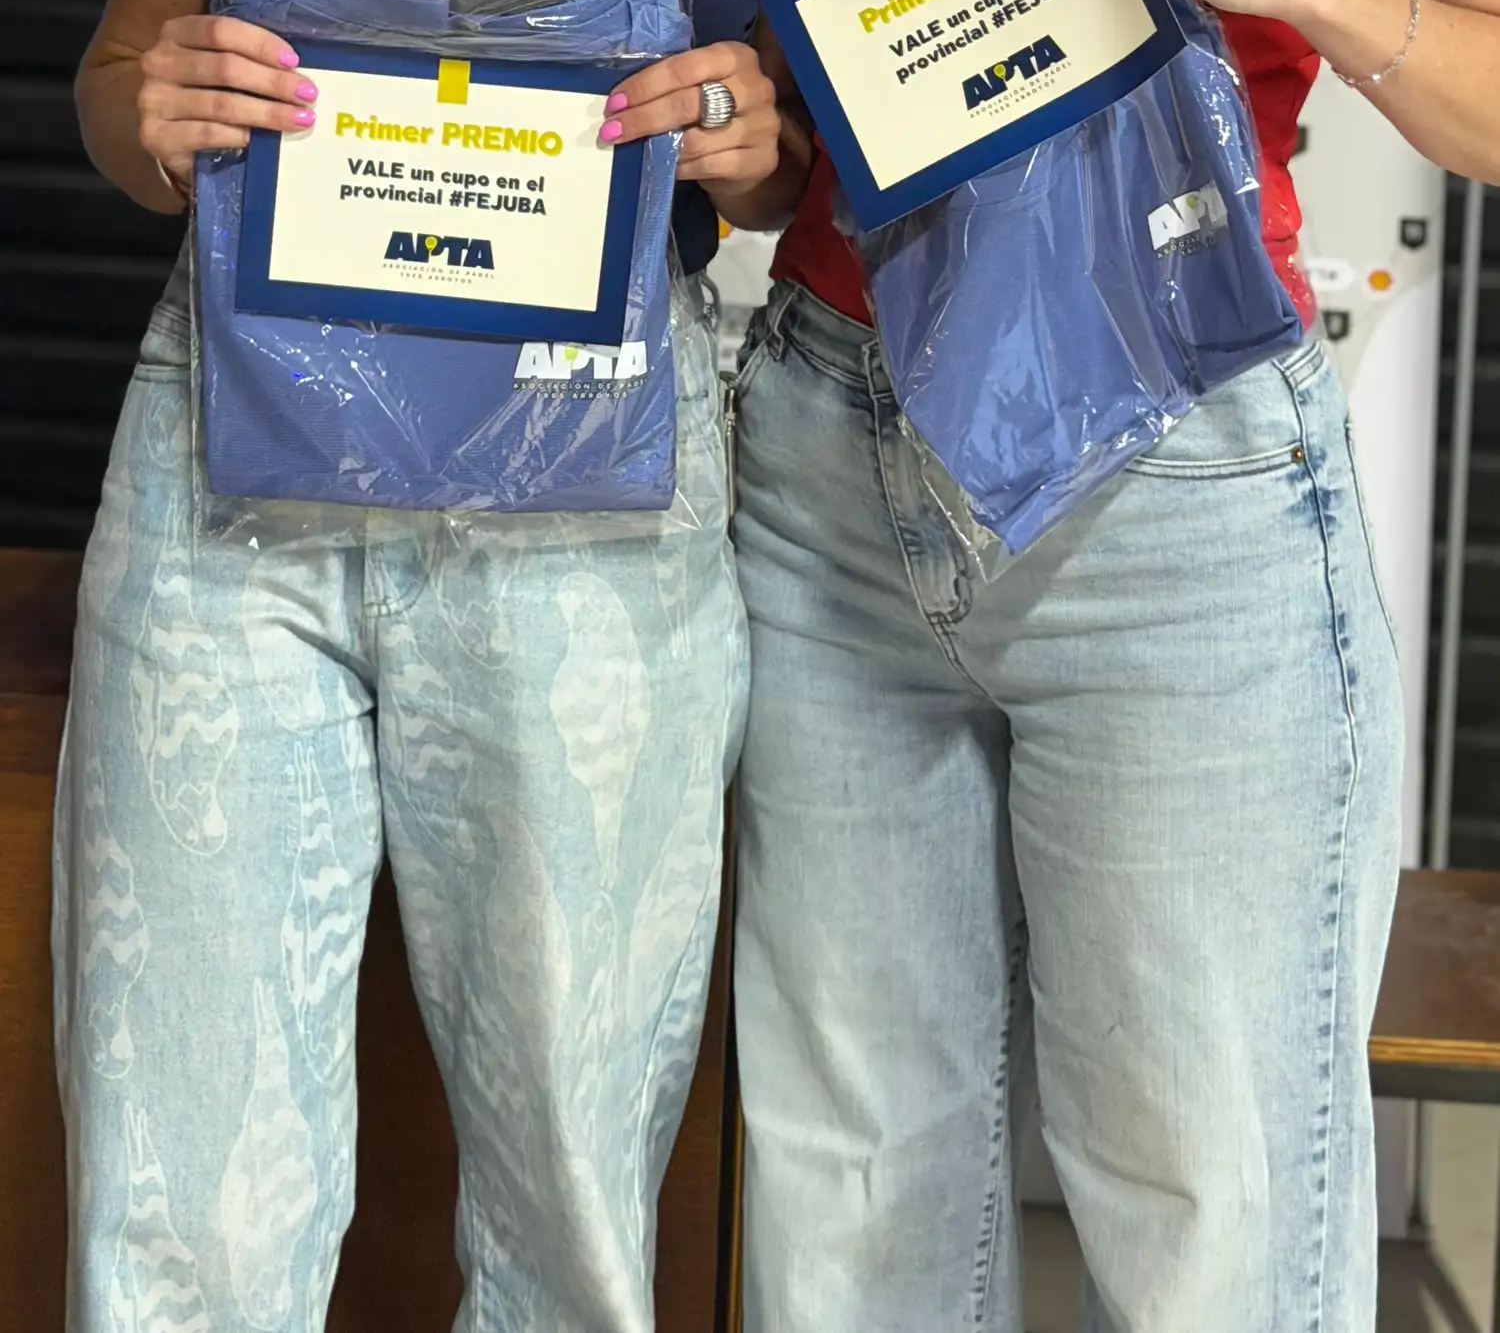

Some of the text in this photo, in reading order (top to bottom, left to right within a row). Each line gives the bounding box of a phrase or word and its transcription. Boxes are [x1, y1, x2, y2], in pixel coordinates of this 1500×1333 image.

[889, 19, 945, 57] VALE
[947, 8, 971, 28] un
[895, 20, 990, 84] provincial
[962, 34, 1068, 111] APTA
[335, 112, 564, 157] Primer PREMIO
[348, 158, 545, 192] VALE un cupo en el
[340, 184, 547, 216] provincial #FEJUBA
[384, 231, 495, 270] APTA
[514, 340, 648, 379] APTA
